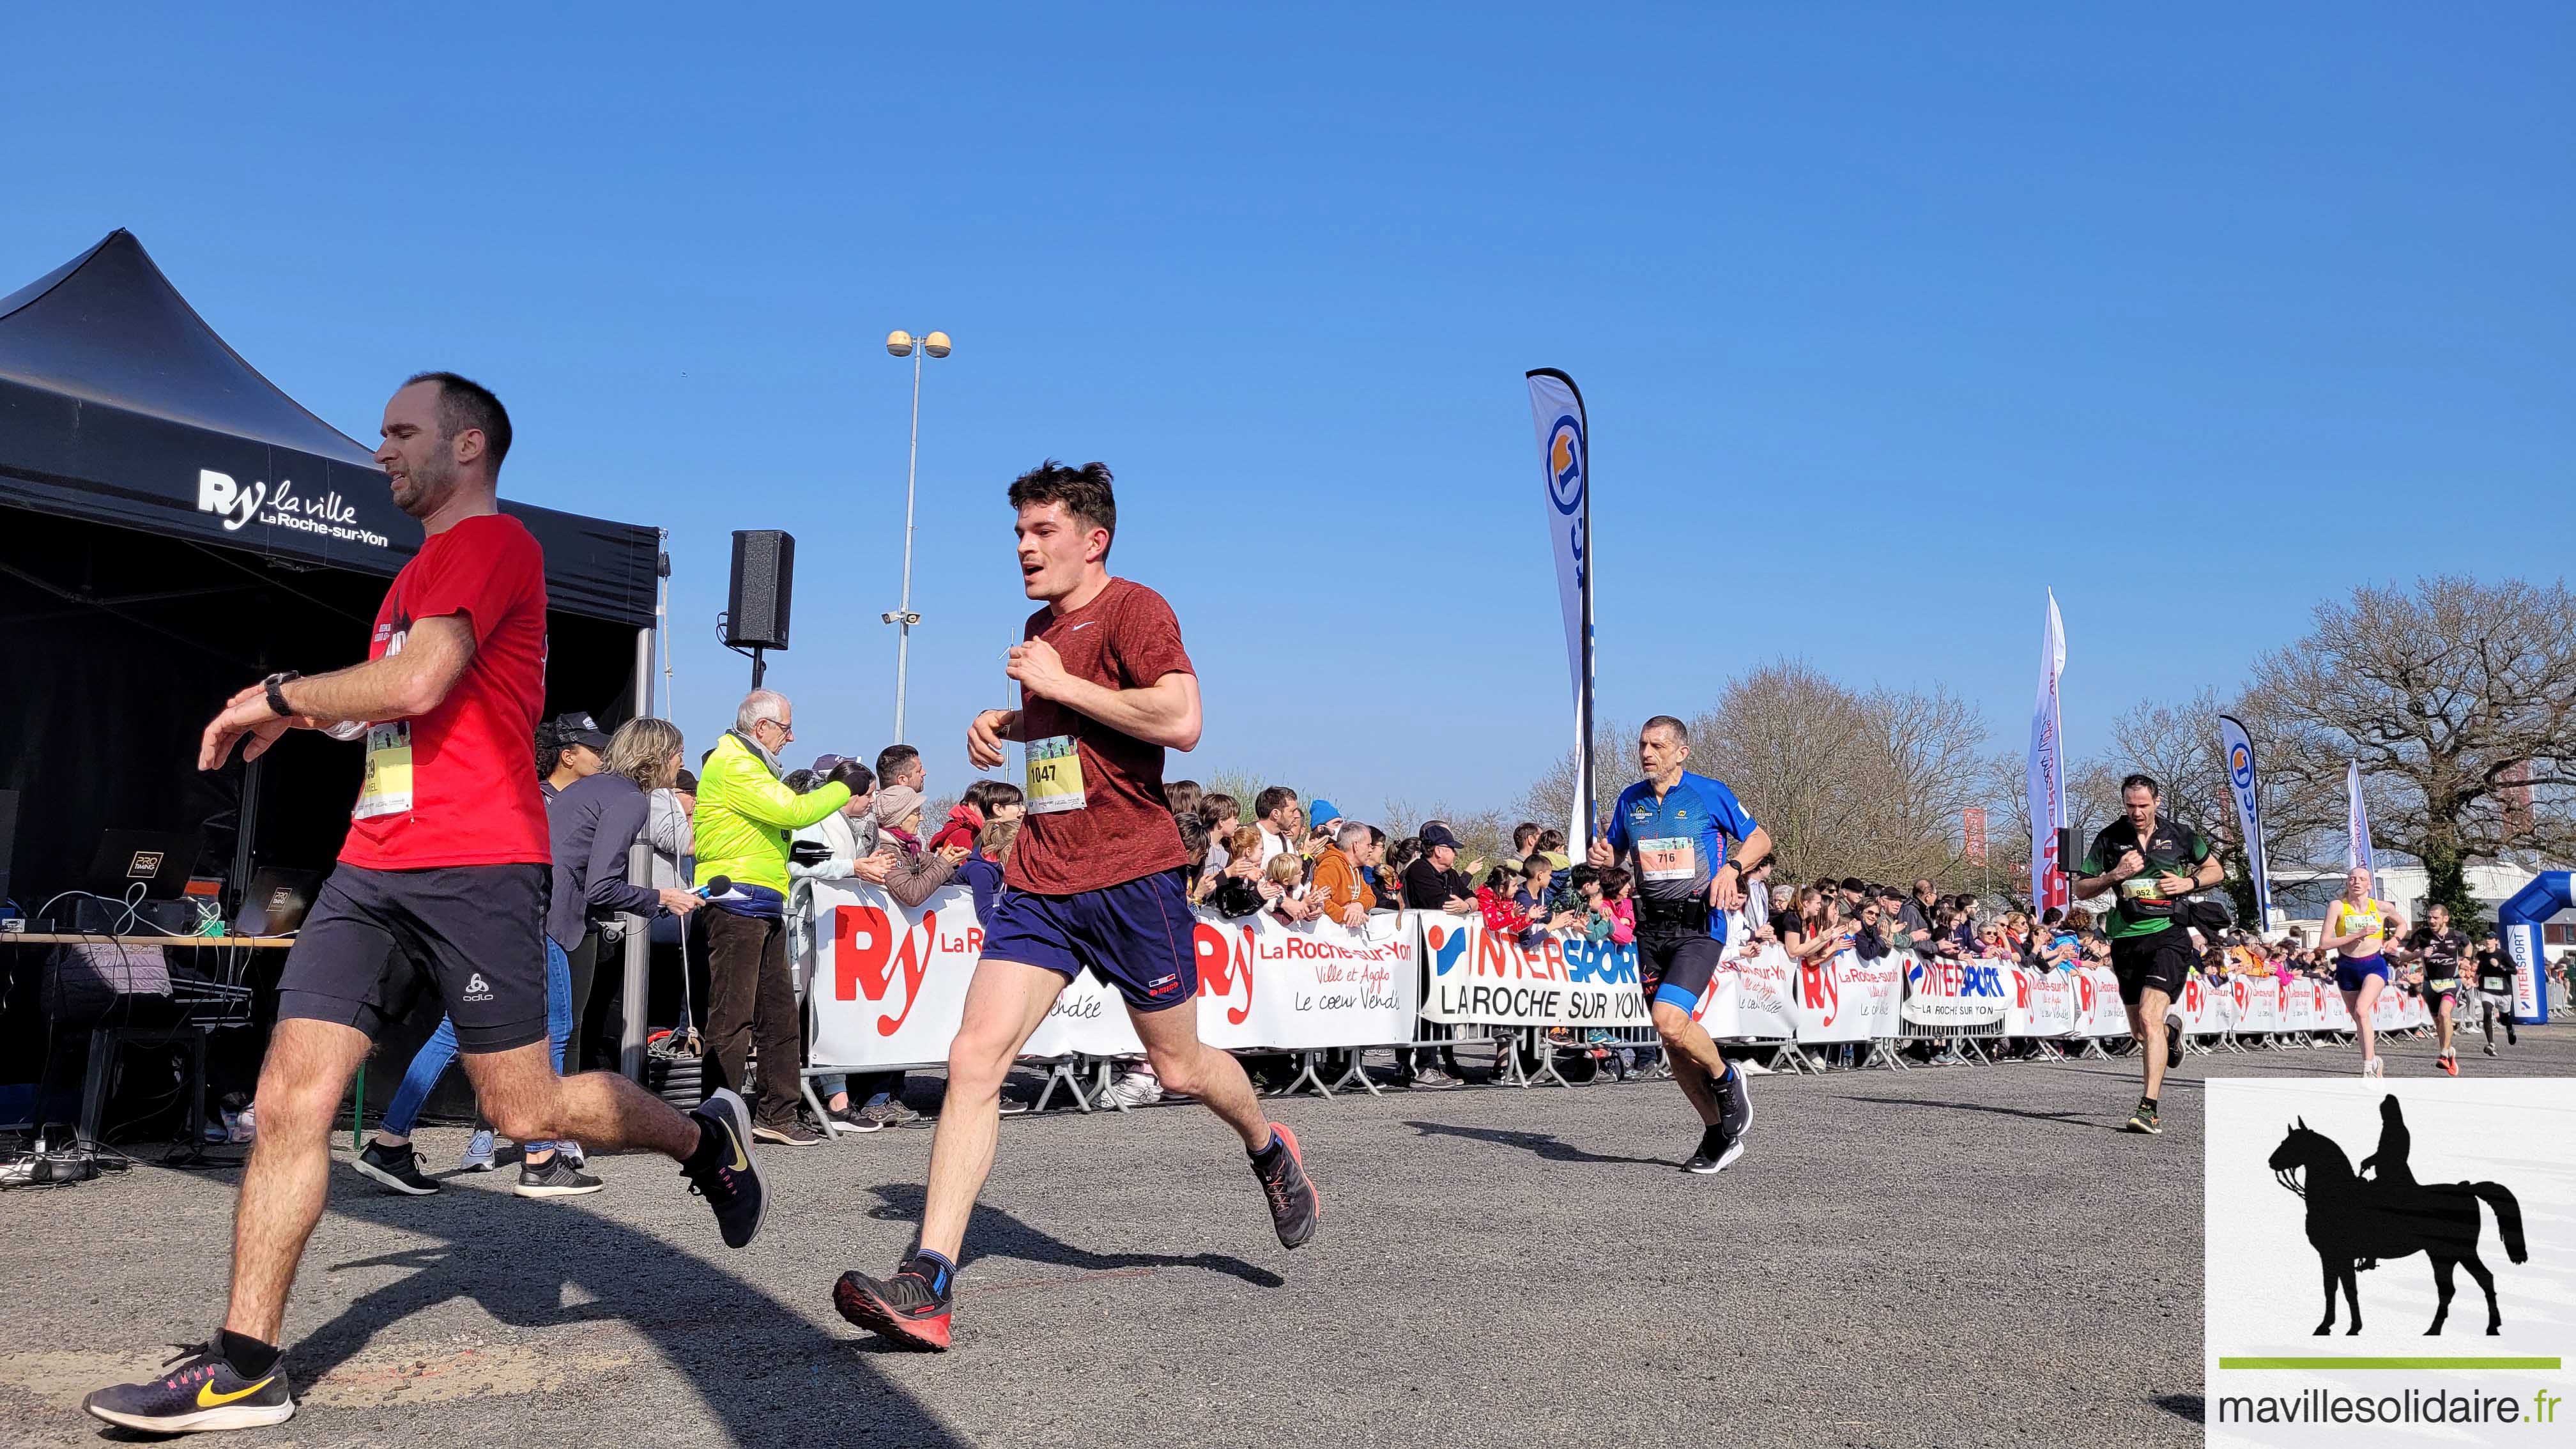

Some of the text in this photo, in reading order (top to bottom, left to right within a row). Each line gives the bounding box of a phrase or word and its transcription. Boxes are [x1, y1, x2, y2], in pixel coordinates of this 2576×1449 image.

[198, 469, 266, 530] Ry
[266, 480, 358, 524] la ville
[260, 512, 388, 548] La Roche-sur-Yon
[1031, 765, 1056, 783] 1047
[1657, 854, 1675, 862] 716
[941, 933, 962, 953] La
[1261, 937, 1411, 962] La Roche-sur-Yon
[835, 905, 936, 1036] Ry
[1193, 923, 1255, 1025] Ry
[1315, 965, 1390, 994] Ville et Agglo
[1838, 973, 1850, 983] La
[2514, 933, 2531, 999] INTERSPORT
[1295, 992, 1312, 1011] Le
[1568, 992, 1607, 1019] SUR
[1615, 993, 1646, 1019] YON
[1800, 959, 1838, 1027] Ry
[1922, 1005, 1994, 1015] LA ROCHE SUR YON
